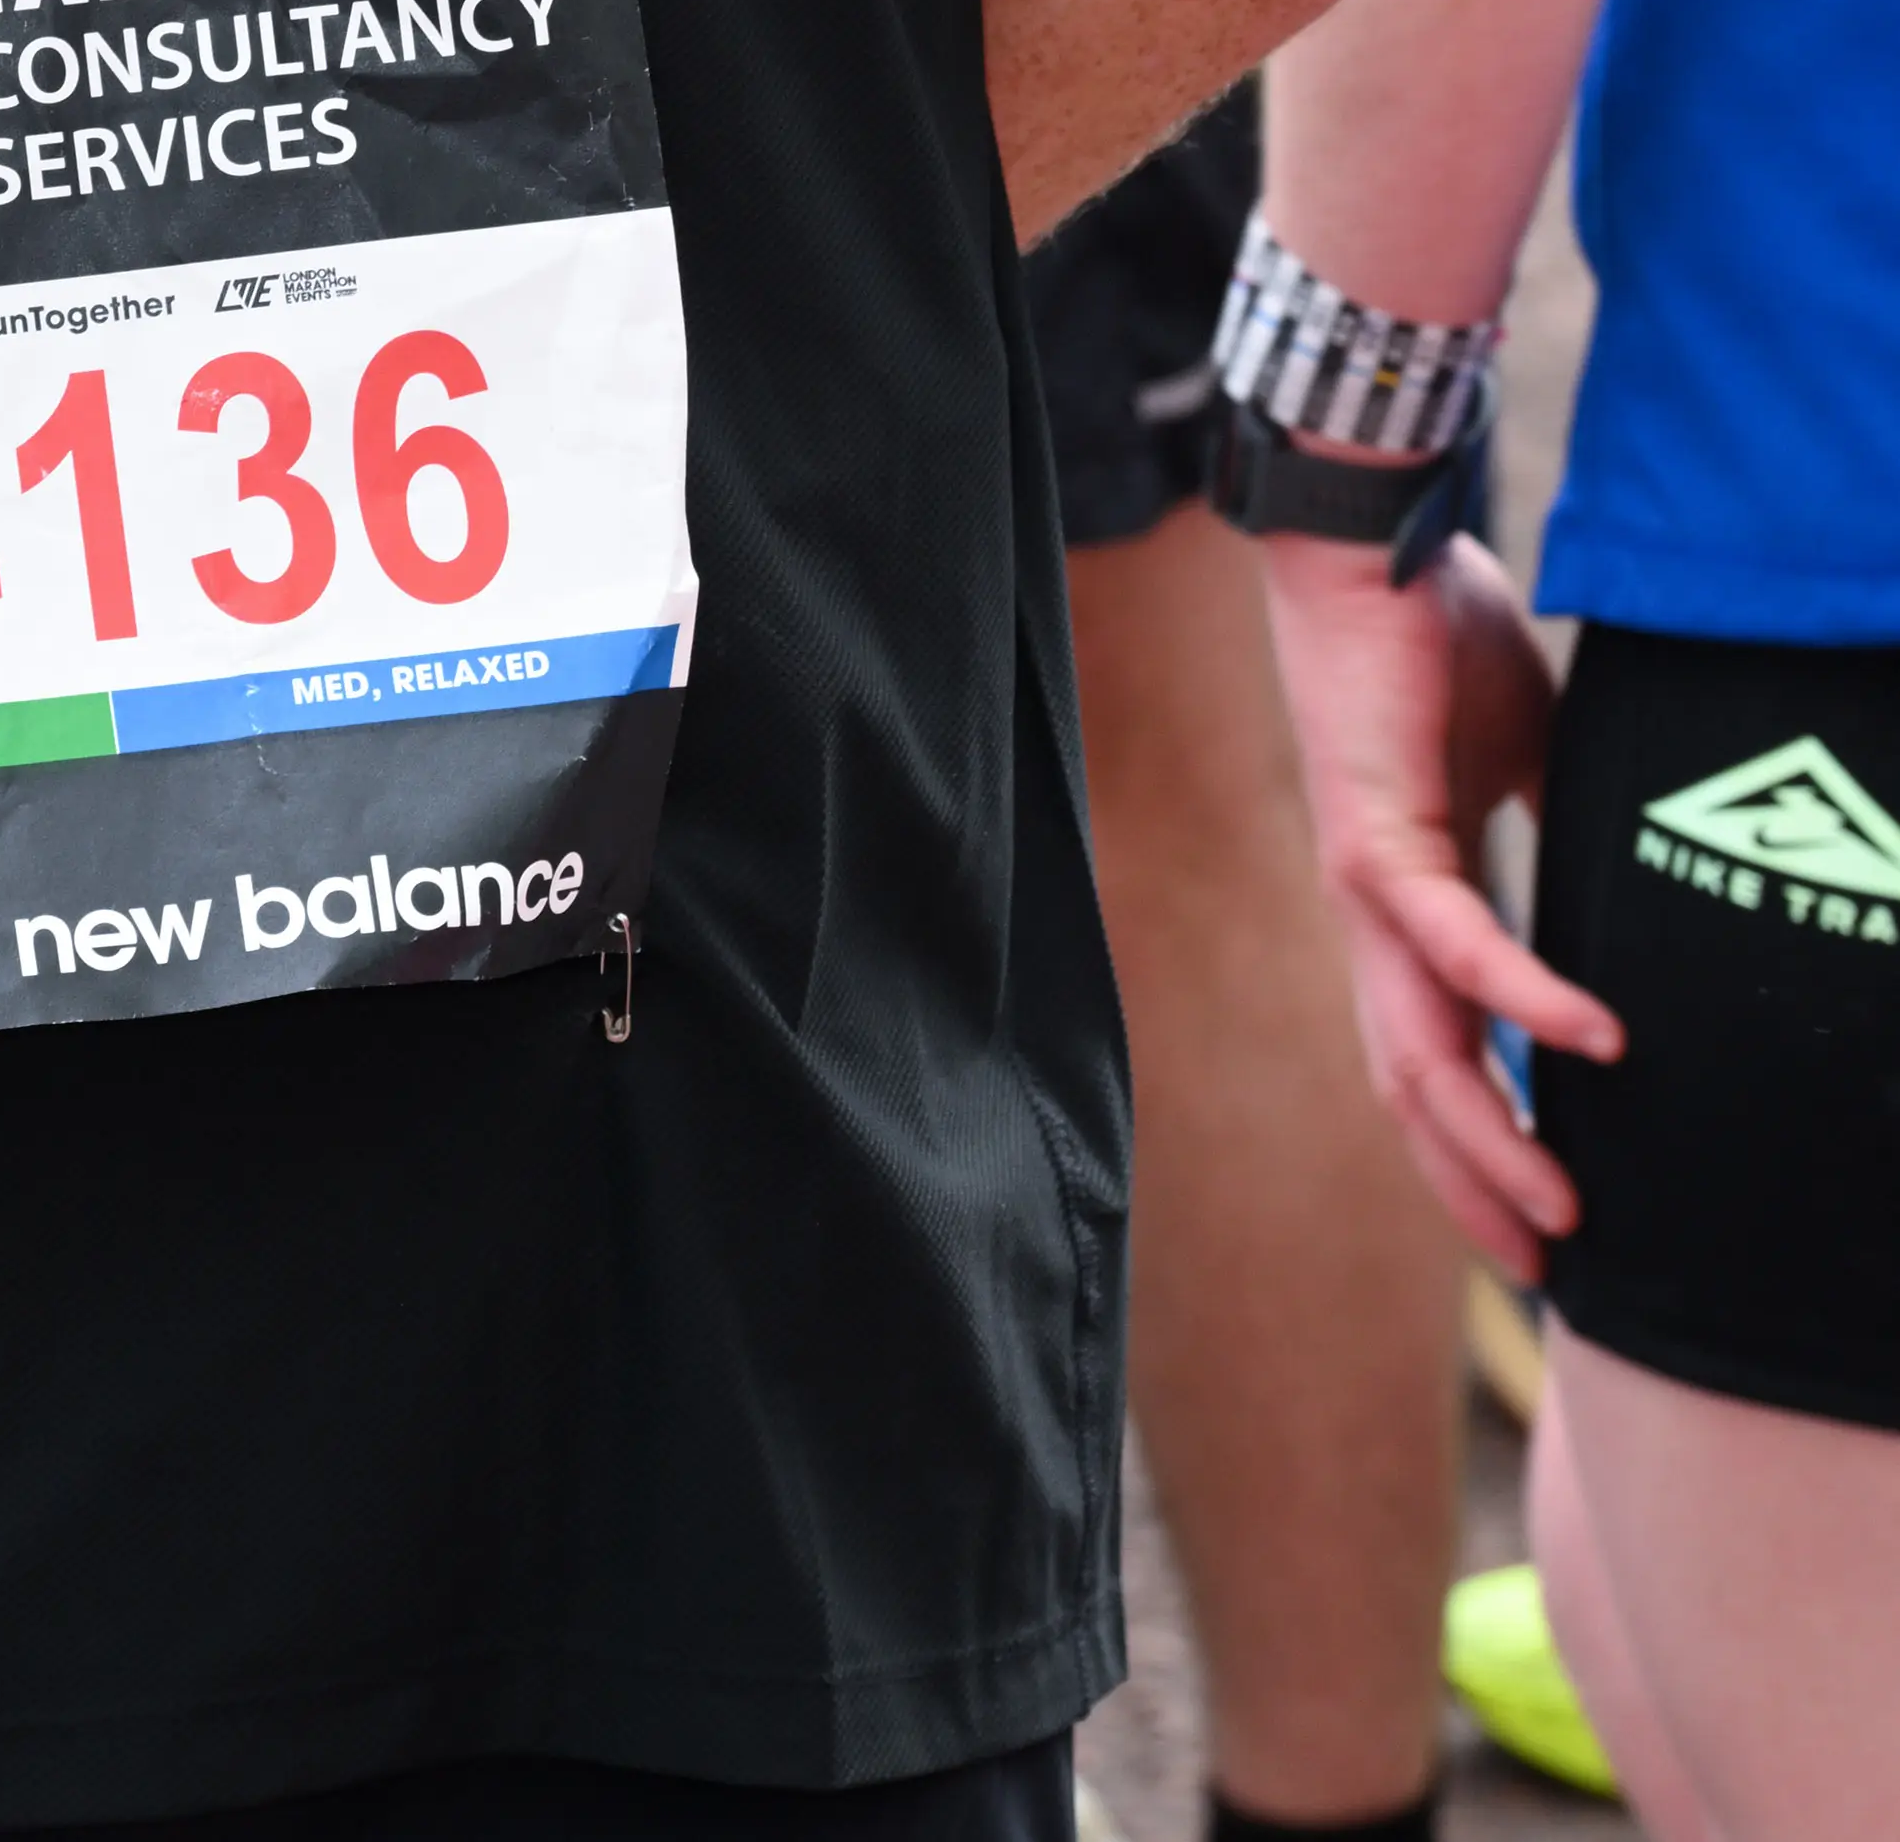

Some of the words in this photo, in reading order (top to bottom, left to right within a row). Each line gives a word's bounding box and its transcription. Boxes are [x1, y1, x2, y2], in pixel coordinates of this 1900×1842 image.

[283, 267, 336, 283] LONDON
[284, 275, 357, 294] MARATHON
[285, 289, 331, 304] EVENTS
[292, 668, 382, 706] MED,
[391, 649, 551, 696] RELAXED
[1635, 827, 1764, 911] NIKE
[15, 895, 210, 979] new
[234, 850, 585, 954] balance
